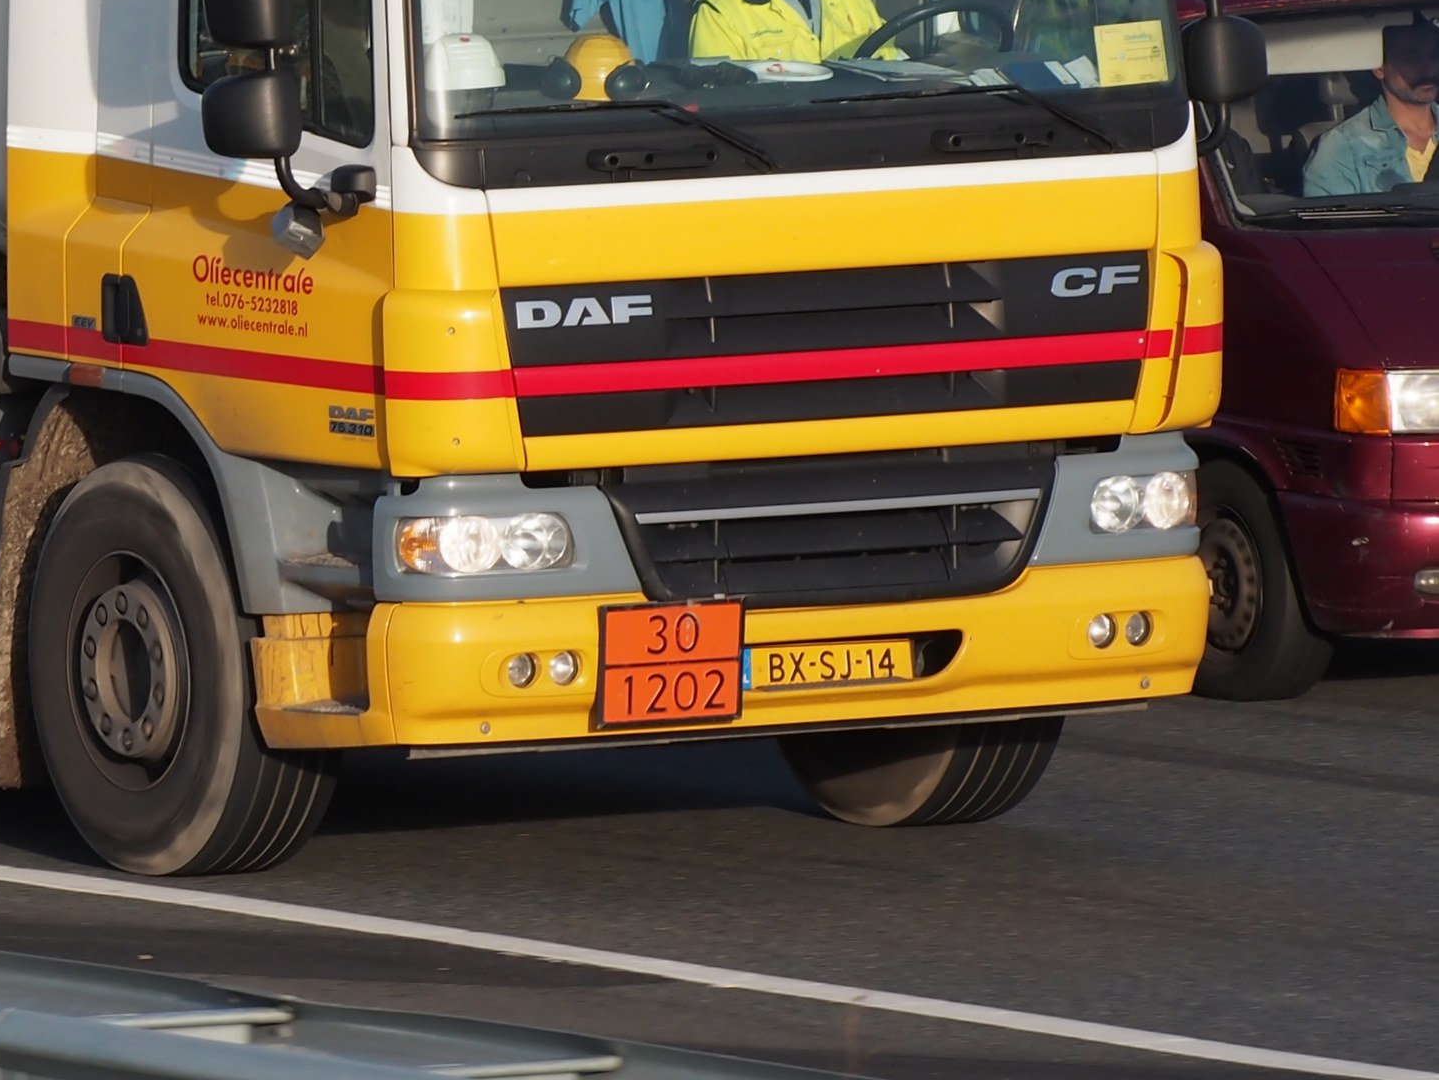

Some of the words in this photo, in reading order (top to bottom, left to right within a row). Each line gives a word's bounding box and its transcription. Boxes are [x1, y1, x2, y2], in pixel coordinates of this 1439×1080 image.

[192, 254, 314, 295] Oliecentrale
[206, 291, 299, 316] tel.076-5232818
[515, 294, 653, 330] DAF
[1050, 264, 1141, 298] CF
[74, 316, 94, 328] EEV
[197, 314, 309, 338] www.oliecentrale.nl
[328, 405, 375, 421] DAF
[647, 612, 700, 655] 30
[769, 648, 895, 683] BX-SJ-14
[624, 669, 726, 716] 1202
